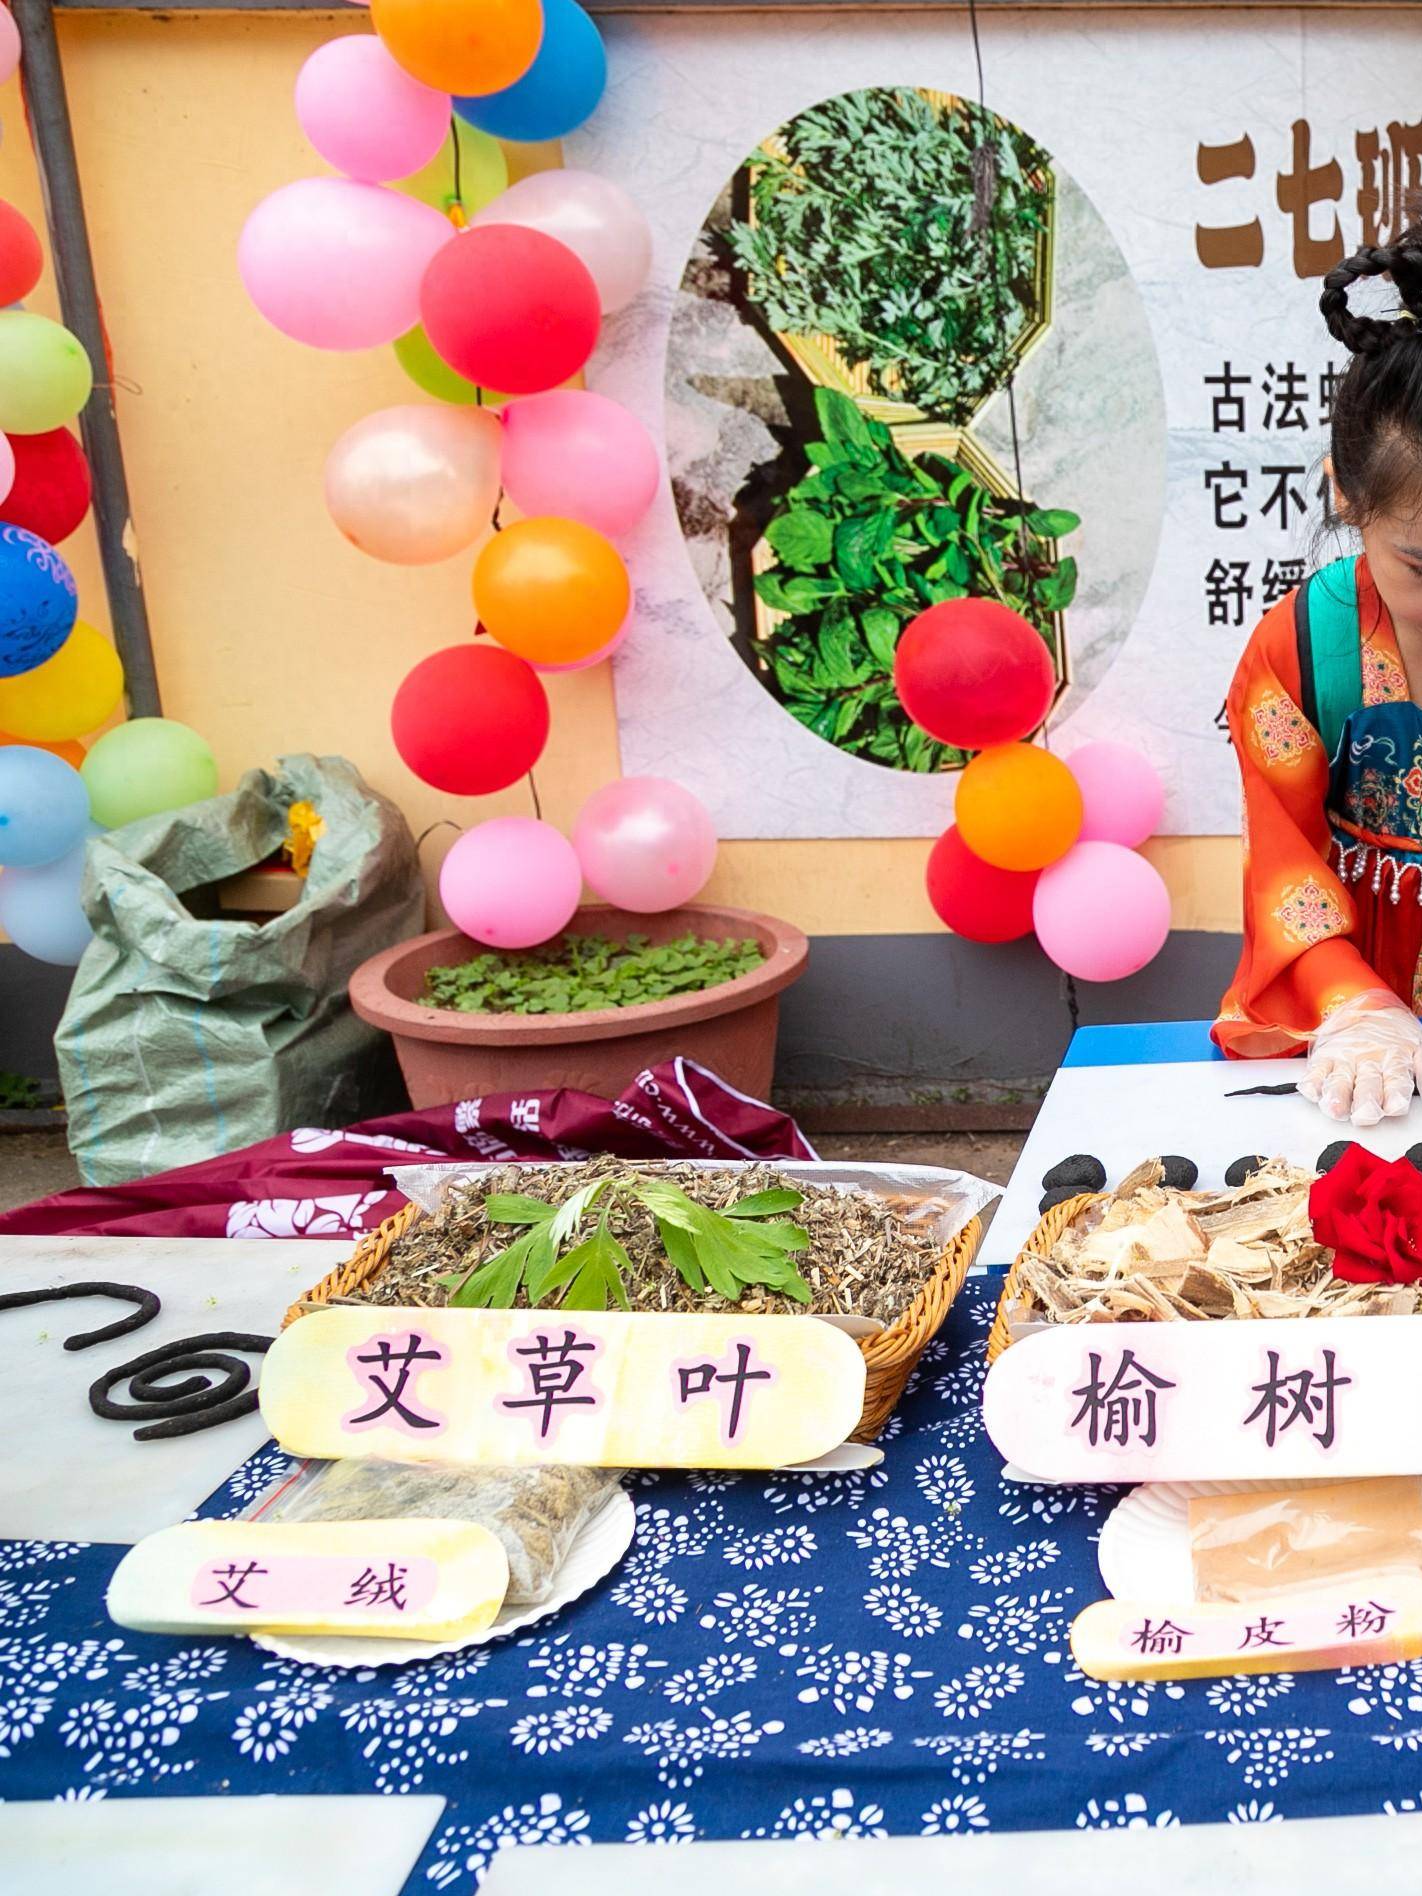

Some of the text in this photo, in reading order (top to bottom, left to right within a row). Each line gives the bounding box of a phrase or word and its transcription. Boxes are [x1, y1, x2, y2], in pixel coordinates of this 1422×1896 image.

[350, 1331, 771, 1438] 艾草叶
[201, 1561, 408, 1611] 艾绒
[1133, 1600, 1398, 1654] 榆皮粉
